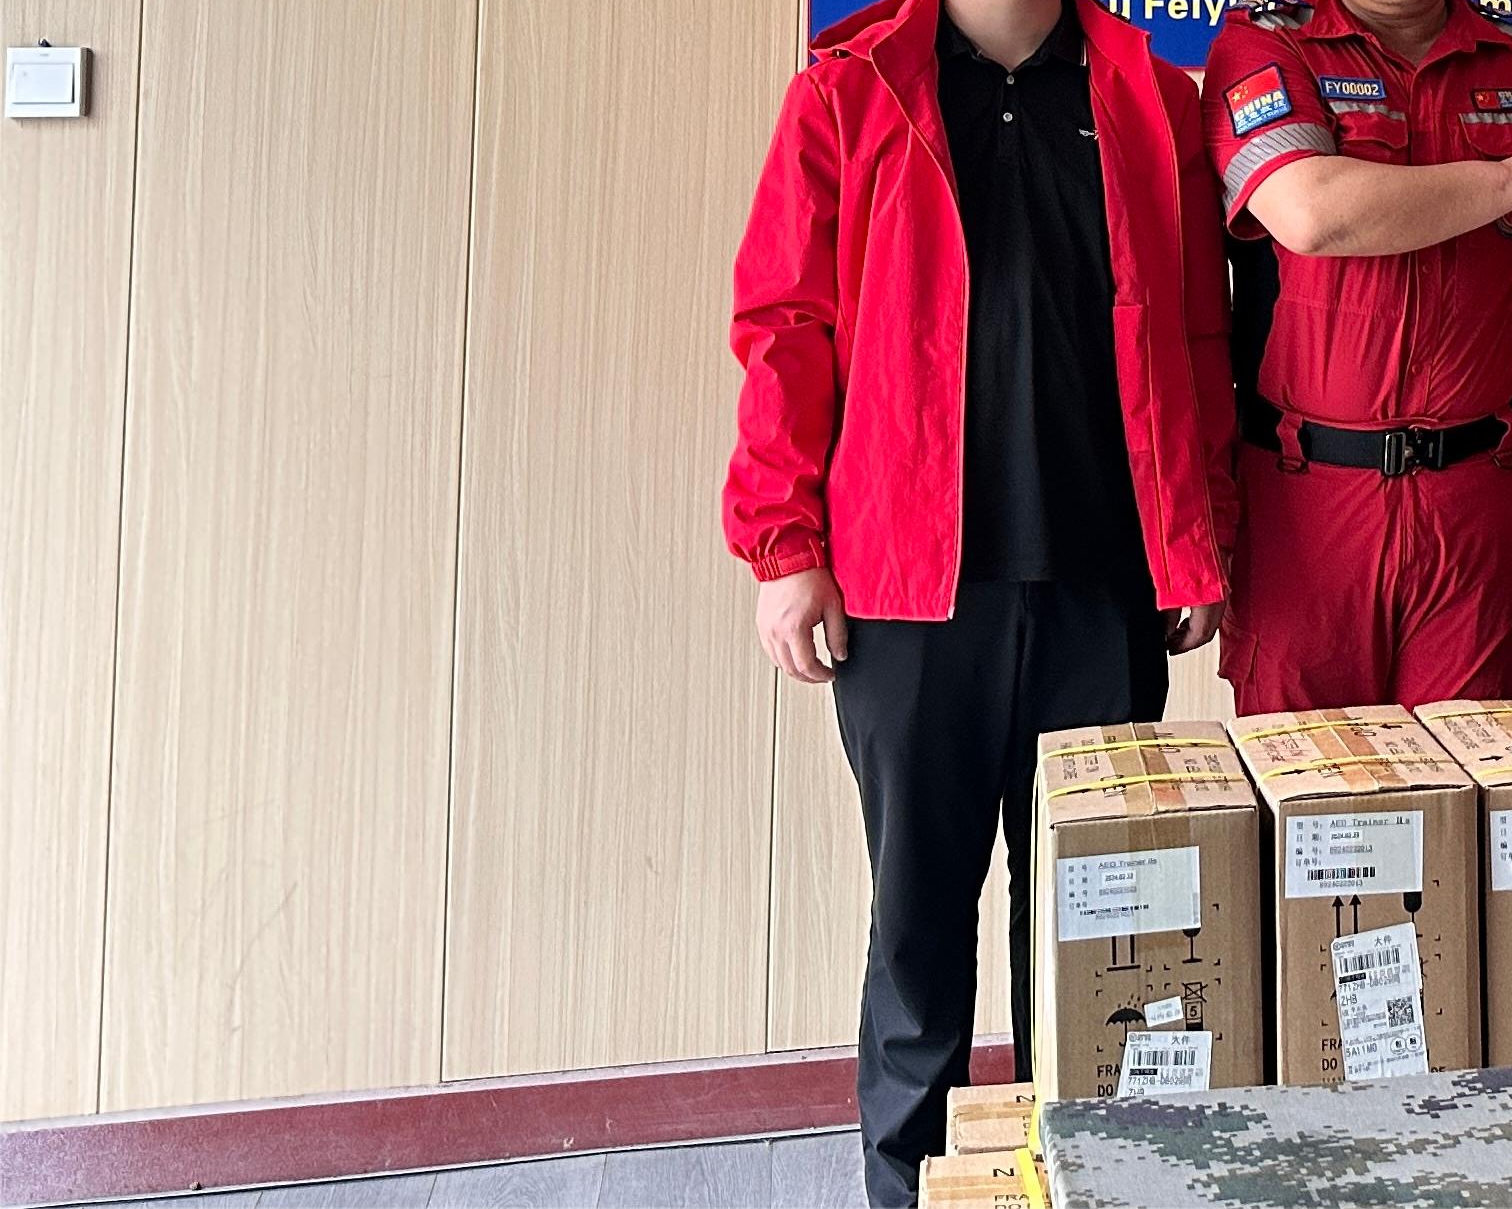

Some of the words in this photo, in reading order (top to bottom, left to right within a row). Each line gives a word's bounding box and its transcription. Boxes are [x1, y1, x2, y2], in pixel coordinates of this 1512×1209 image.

[1325, 79, 1380, 96] FY00002
[1234, 90, 1285, 122] CHINA
[1321, 1058, 1338, 1071] DO
[1098, 1084, 1114, 1097] DO
